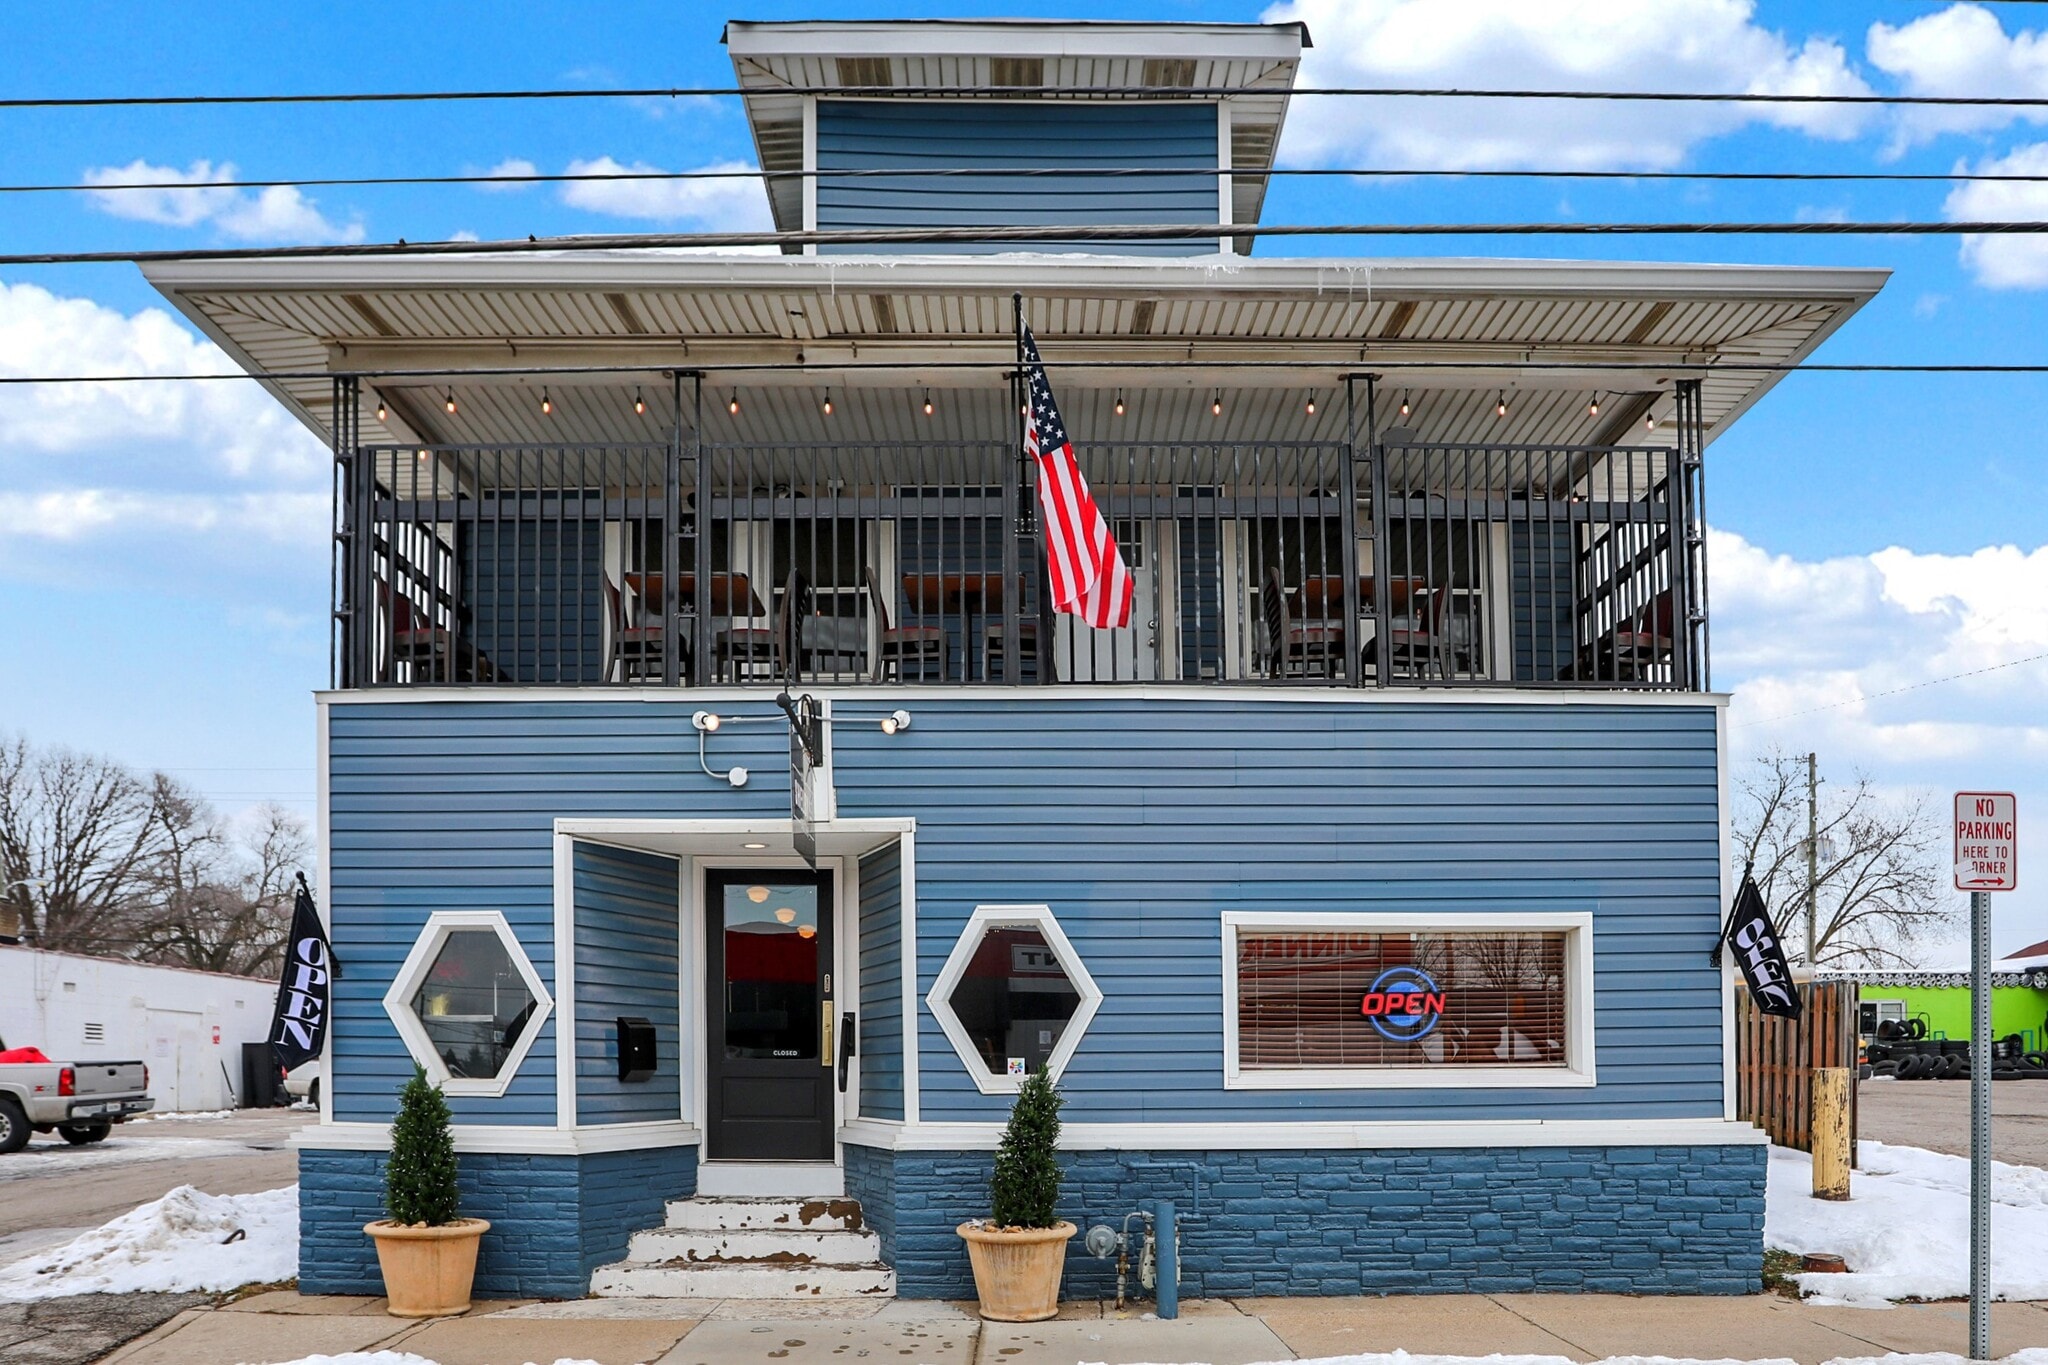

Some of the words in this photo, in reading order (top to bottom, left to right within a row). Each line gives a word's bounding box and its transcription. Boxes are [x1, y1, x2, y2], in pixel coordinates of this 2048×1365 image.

[1976, 799, 1994, 817] NO
[1959, 821, 2012, 840] PARKING
[1963, 846, 1989, 858] HERE
[1995, 846, 2008, 858] TO
[1972, 861, 2006, 874] ORNER
[1736, 917, 1792, 1009] OPEN
[274, 937, 327, 1051] OPEN
[1362, 993, 1446, 1015] OPEN
